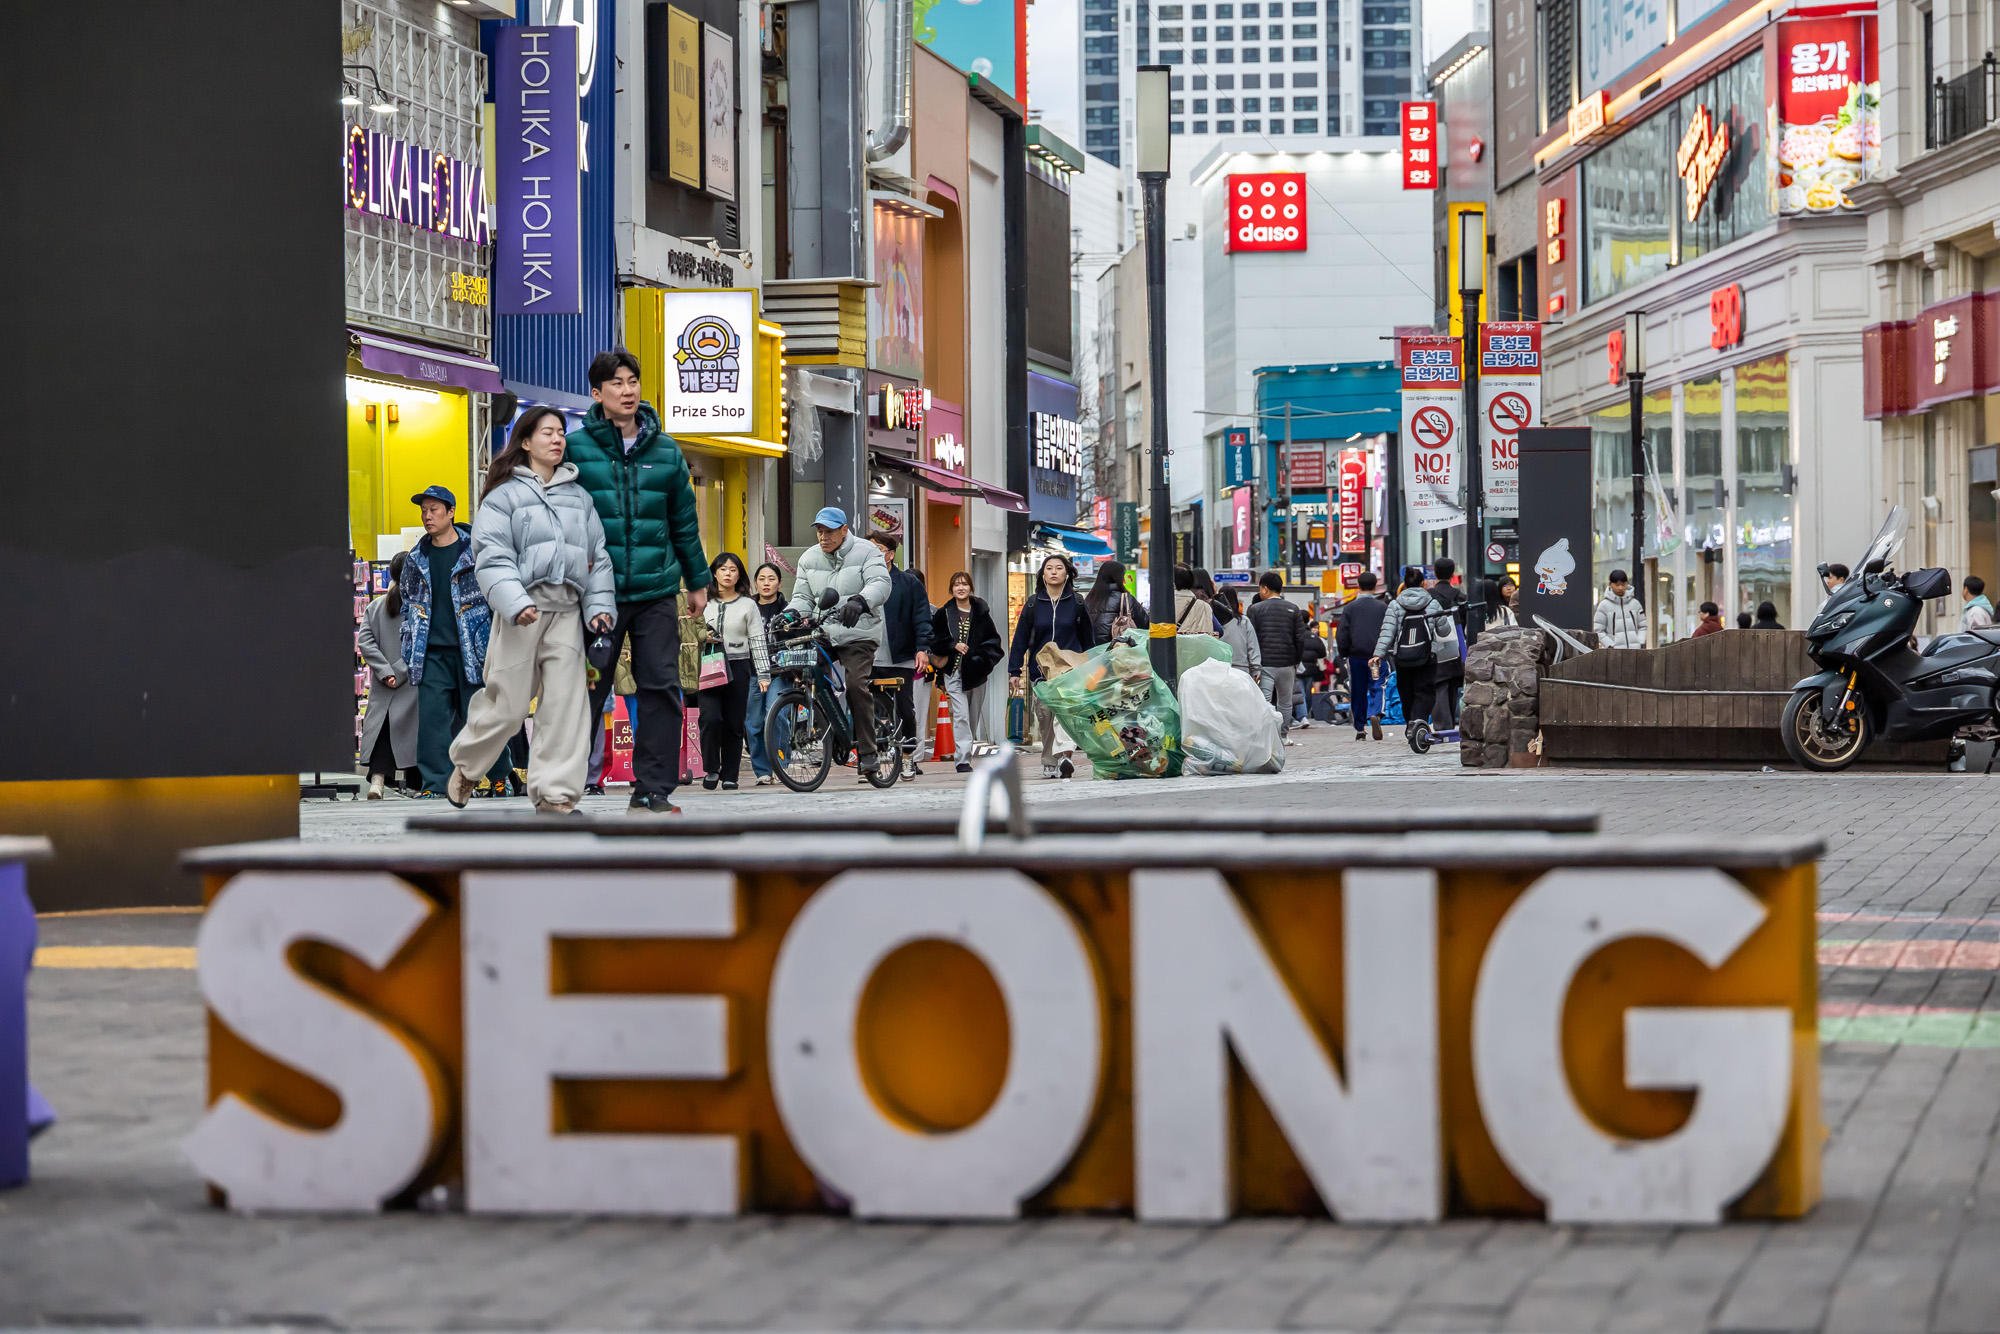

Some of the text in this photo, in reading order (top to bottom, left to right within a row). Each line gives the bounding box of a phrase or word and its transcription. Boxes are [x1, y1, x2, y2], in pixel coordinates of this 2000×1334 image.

[1791, 40, 1850, 74] 용가
[1409, 106, 1432, 184] 금강제화
[520, 32, 553, 307] HOLIKA HOLIKA
[1239, 222, 1299, 242] daiso
[1490, 335, 1532, 351] 동성로
[1411, 350, 1452, 365] 동성로
[1483, 352, 1538, 367] 금연거리
[679, 369, 740, 393] 캐칭덕
[1405, 367, 1459, 381] 금연거리
[672, 405, 745, 419] Prize Shop
[1414, 452, 1451, 473] NO!
[1415, 474, 1450, 485] SMOKE
[1123, 506, 1131, 556] CROCODILE
[187, 869, 1793, 1225] SEONG
